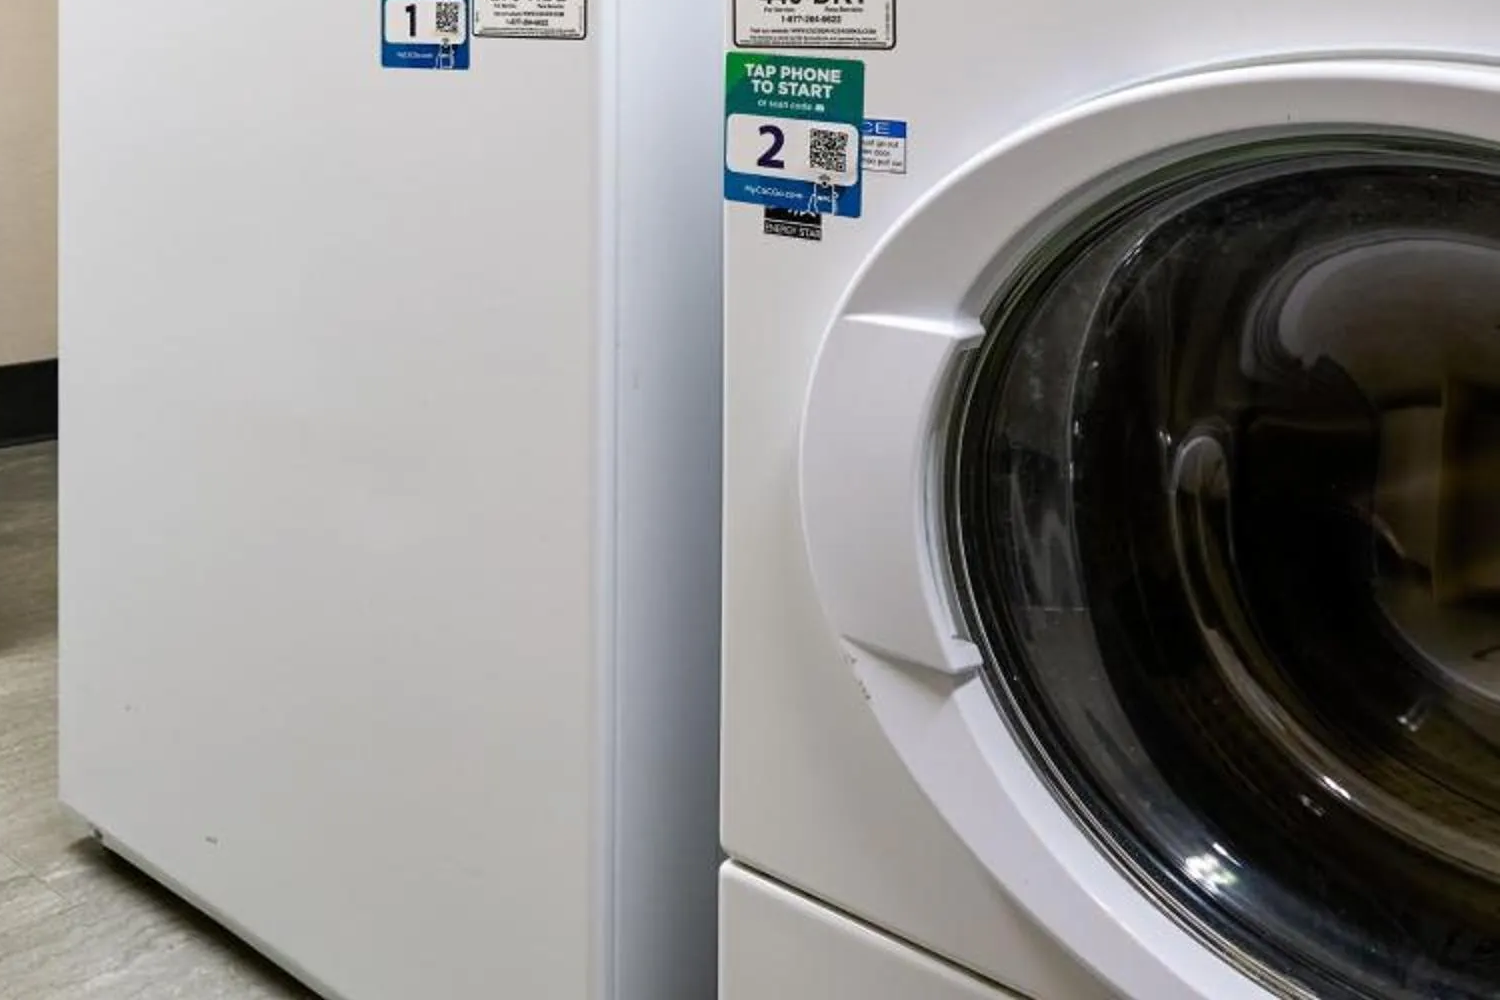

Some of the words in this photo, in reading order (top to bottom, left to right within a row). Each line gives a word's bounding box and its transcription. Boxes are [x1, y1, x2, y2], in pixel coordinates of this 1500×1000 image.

[405, 3, 417, 37] 1
[744, 63, 777, 79] TAP
[780, 65, 842, 84] PHONE
[751, 79, 774, 94] TO
[778, 81, 834, 99] START
[757, 124, 786, 169] 2
